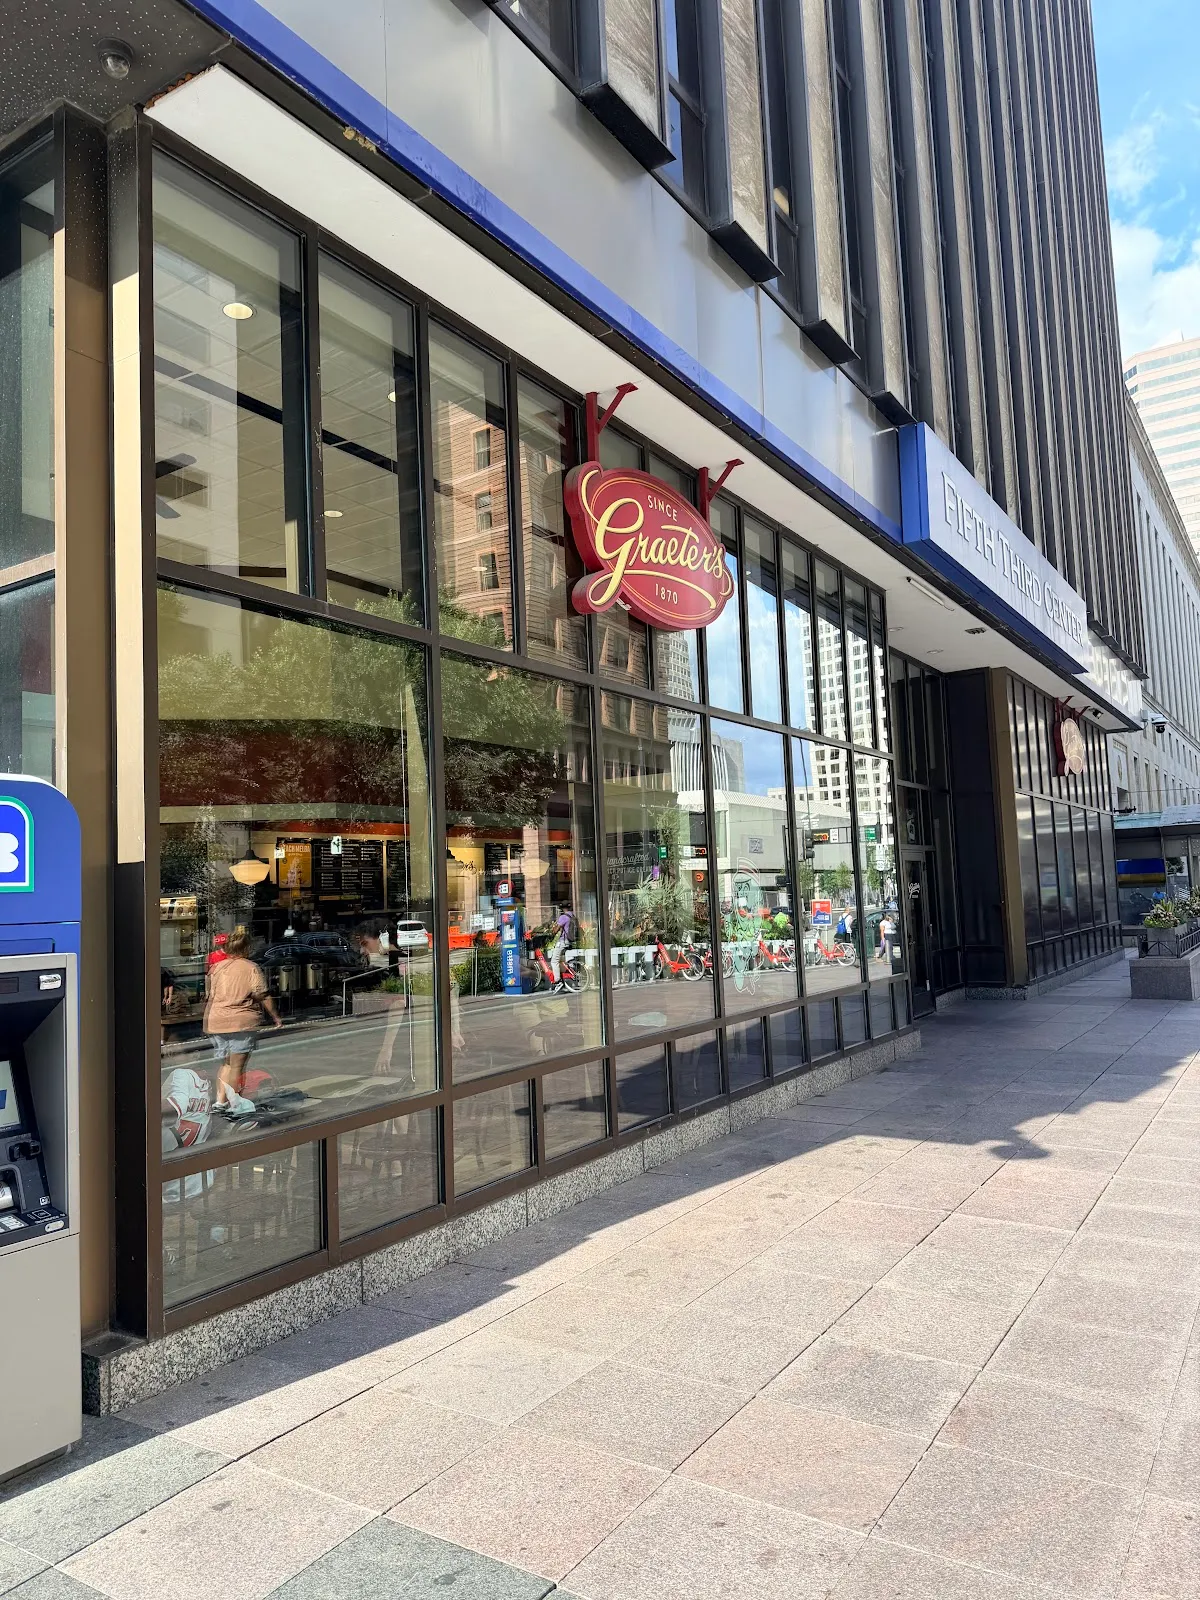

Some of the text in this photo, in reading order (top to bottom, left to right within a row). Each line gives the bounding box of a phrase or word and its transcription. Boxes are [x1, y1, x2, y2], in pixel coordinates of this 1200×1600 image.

[581, 469, 732, 608] Graeter's
[647, 494, 678, 522] SINCE
[655, 583, 678, 604] 1870
[942, 471, 1084, 648] FIFTH THIRD CENTER
